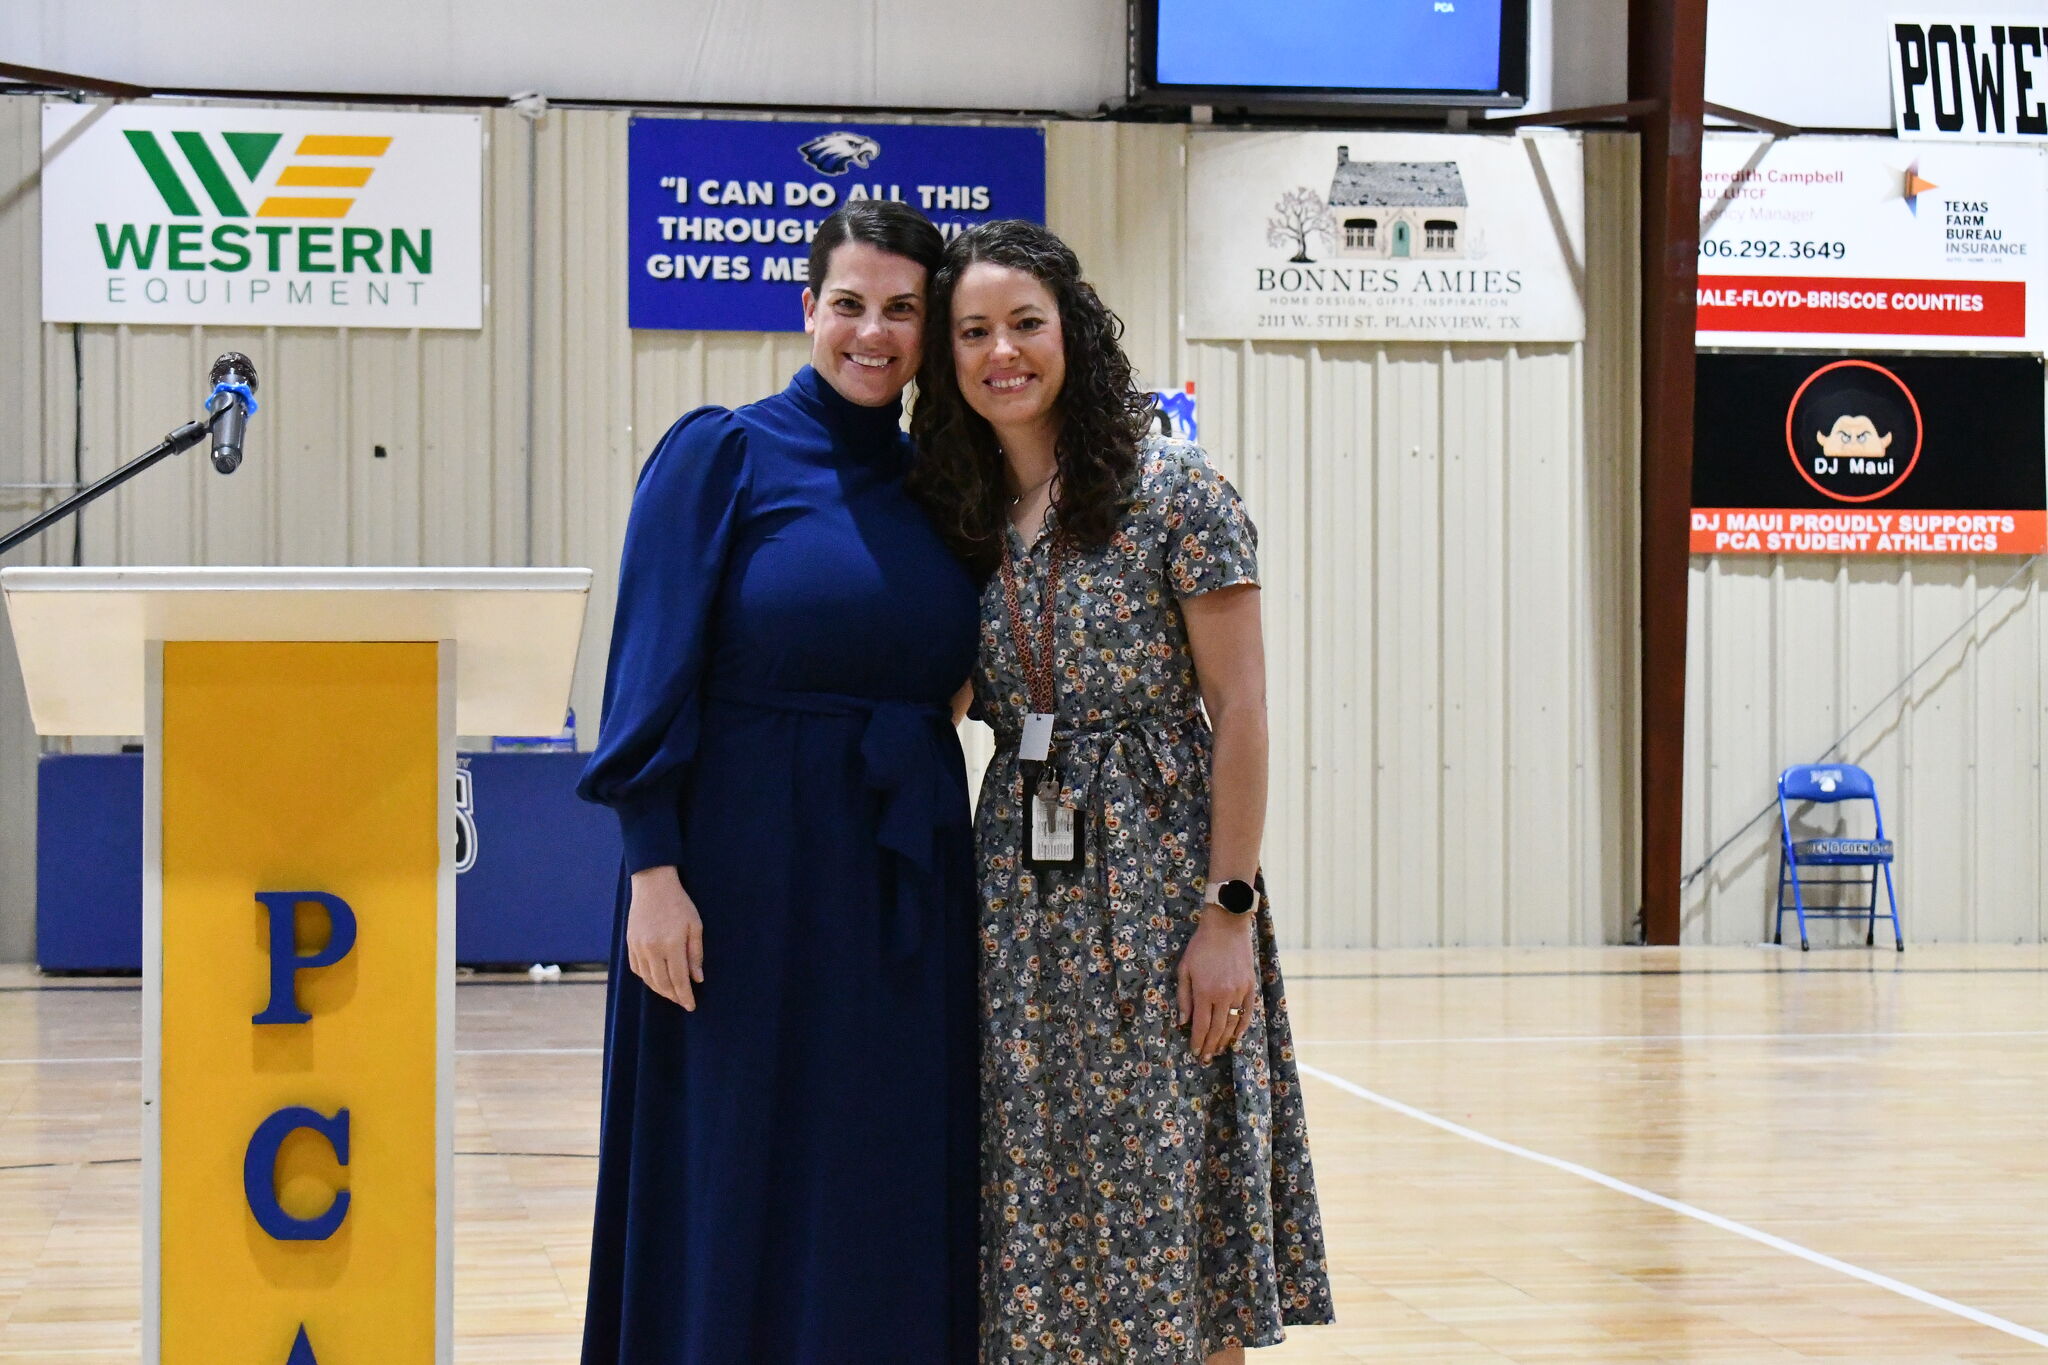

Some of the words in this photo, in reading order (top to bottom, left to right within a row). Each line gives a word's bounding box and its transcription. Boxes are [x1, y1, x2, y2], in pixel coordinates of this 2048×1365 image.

[1895, 23, 2048, 134] POWE
[1701, 169, 1762, 183] eredith
[1768, 170, 1844, 185] Campbell
[698, 180, 773, 206] CAN
[784, 182, 836, 208] DO
[917, 185, 990, 211] THIS
[1750, 207, 1815, 223] Manager
[1944, 201, 1989, 213] TEXAS
[1946, 214, 1984, 226] FARM
[1946, 228, 2002, 241] BUREAU
[96, 223, 432, 274] WESTERN
[1945, 242, 2028, 255] INSURANCE
[646, 254, 751, 281] GIVES
[762, 257, 810, 282] ME
[1257, 268, 1399, 293] BONNES
[1412, 270, 1522, 294] AMIES
[108, 277, 425, 305] EQUIPMENT
[1270, 296, 1309, 306] HOME
[1423, 298, 1508, 307] INSPIRATION
[1891, 293, 1984, 312] COUNTIES
[1257, 315, 1285, 328] 2111
[1292, 315, 1312, 328] W.
[1317, 315, 1348, 328] 5TH
[1354, 315, 1378, 328] ST.
[1499, 316, 1521, 329] TX
[1814, 457, 1838, 475] DJ
[1849, 457, 1895, 475] Maui
[1692, 514, 1720, 532] DJ
[1727, 514, 1783, 532] MAUI
[1790, 515, 1892, 533] PROUDLY
[1899, 515, 2015, 534] SUPPORTS
[1716, 533, 1760, 550] PCA
[1767, 533, 1871, 551] STUDENT
[1878, 534, 1998, 551] ATHLETICS
